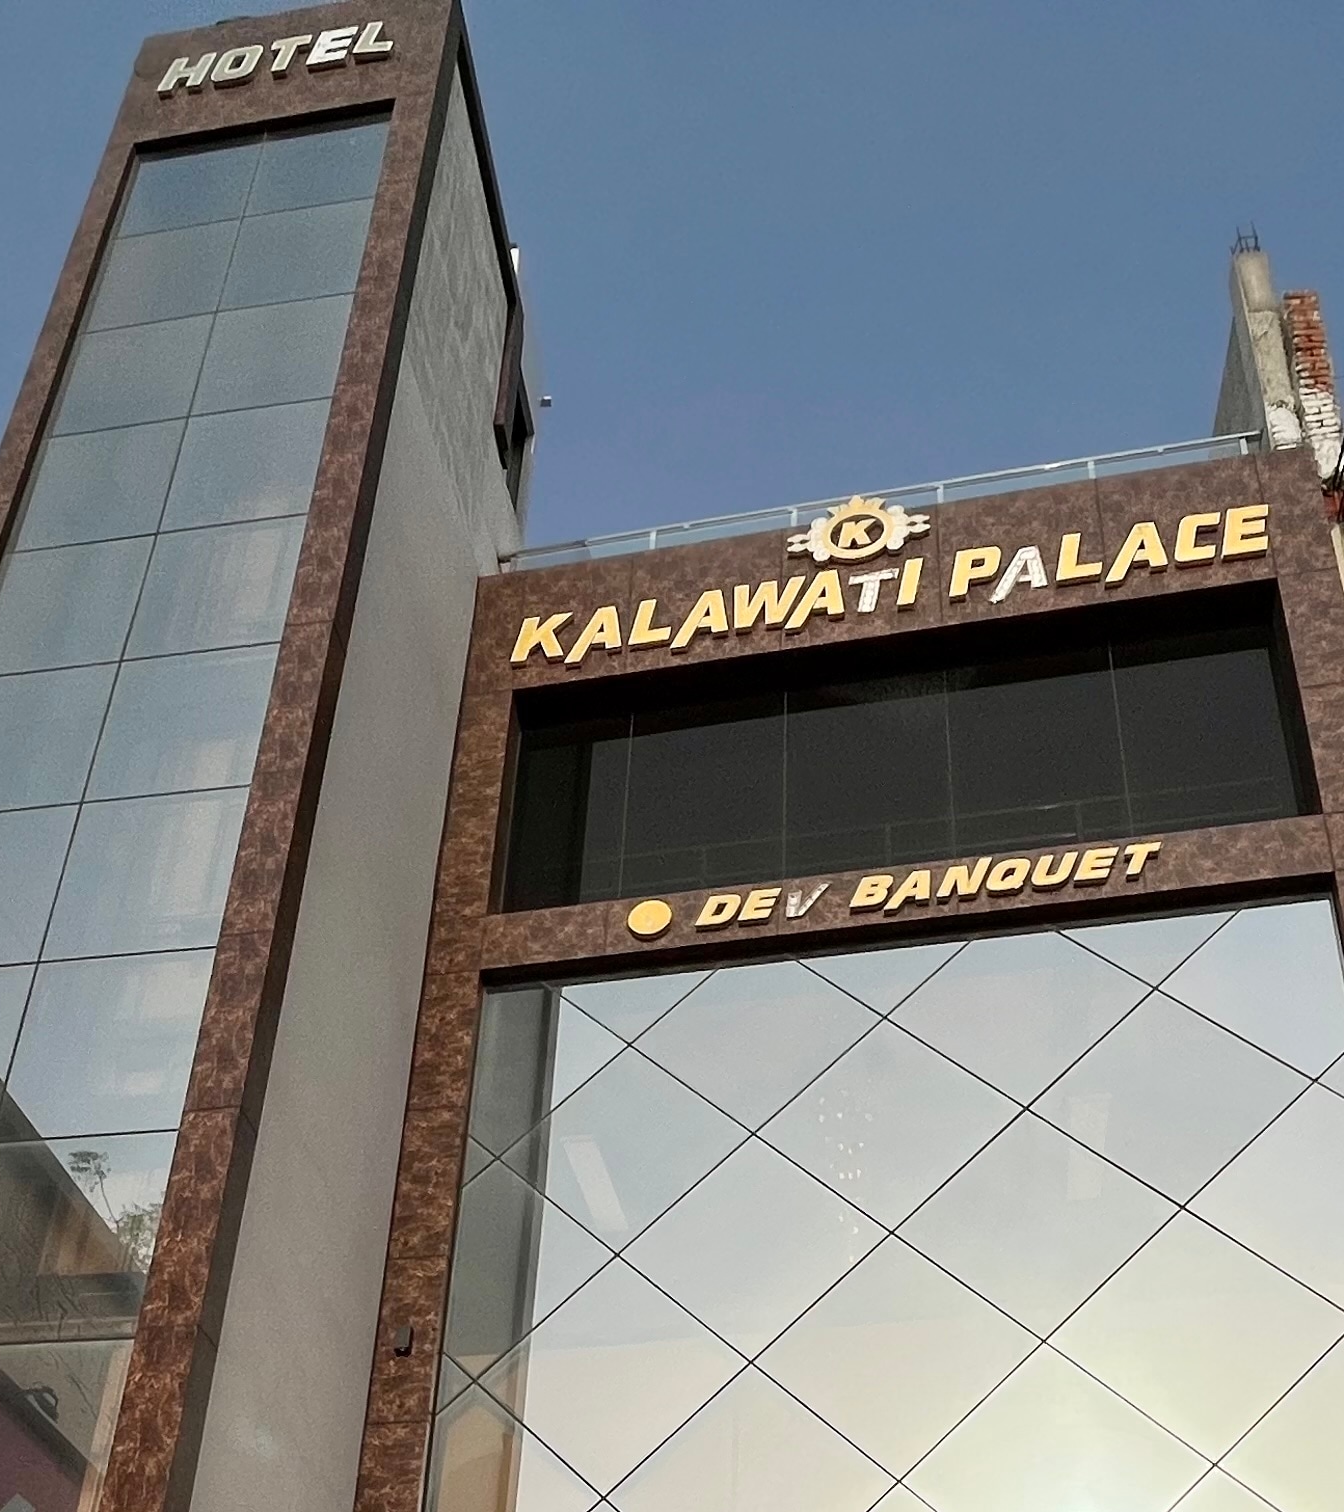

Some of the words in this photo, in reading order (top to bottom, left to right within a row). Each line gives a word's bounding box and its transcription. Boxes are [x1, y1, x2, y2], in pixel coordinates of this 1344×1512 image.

[157, 20, 394, 97] HOTEL
[509, 557, 924, 665] KALAWATI
[948, 504, 1271, 603] PALACE
[694, 881, 829, 929] DEV
[849, 842, 1161, 914] BANQUET
